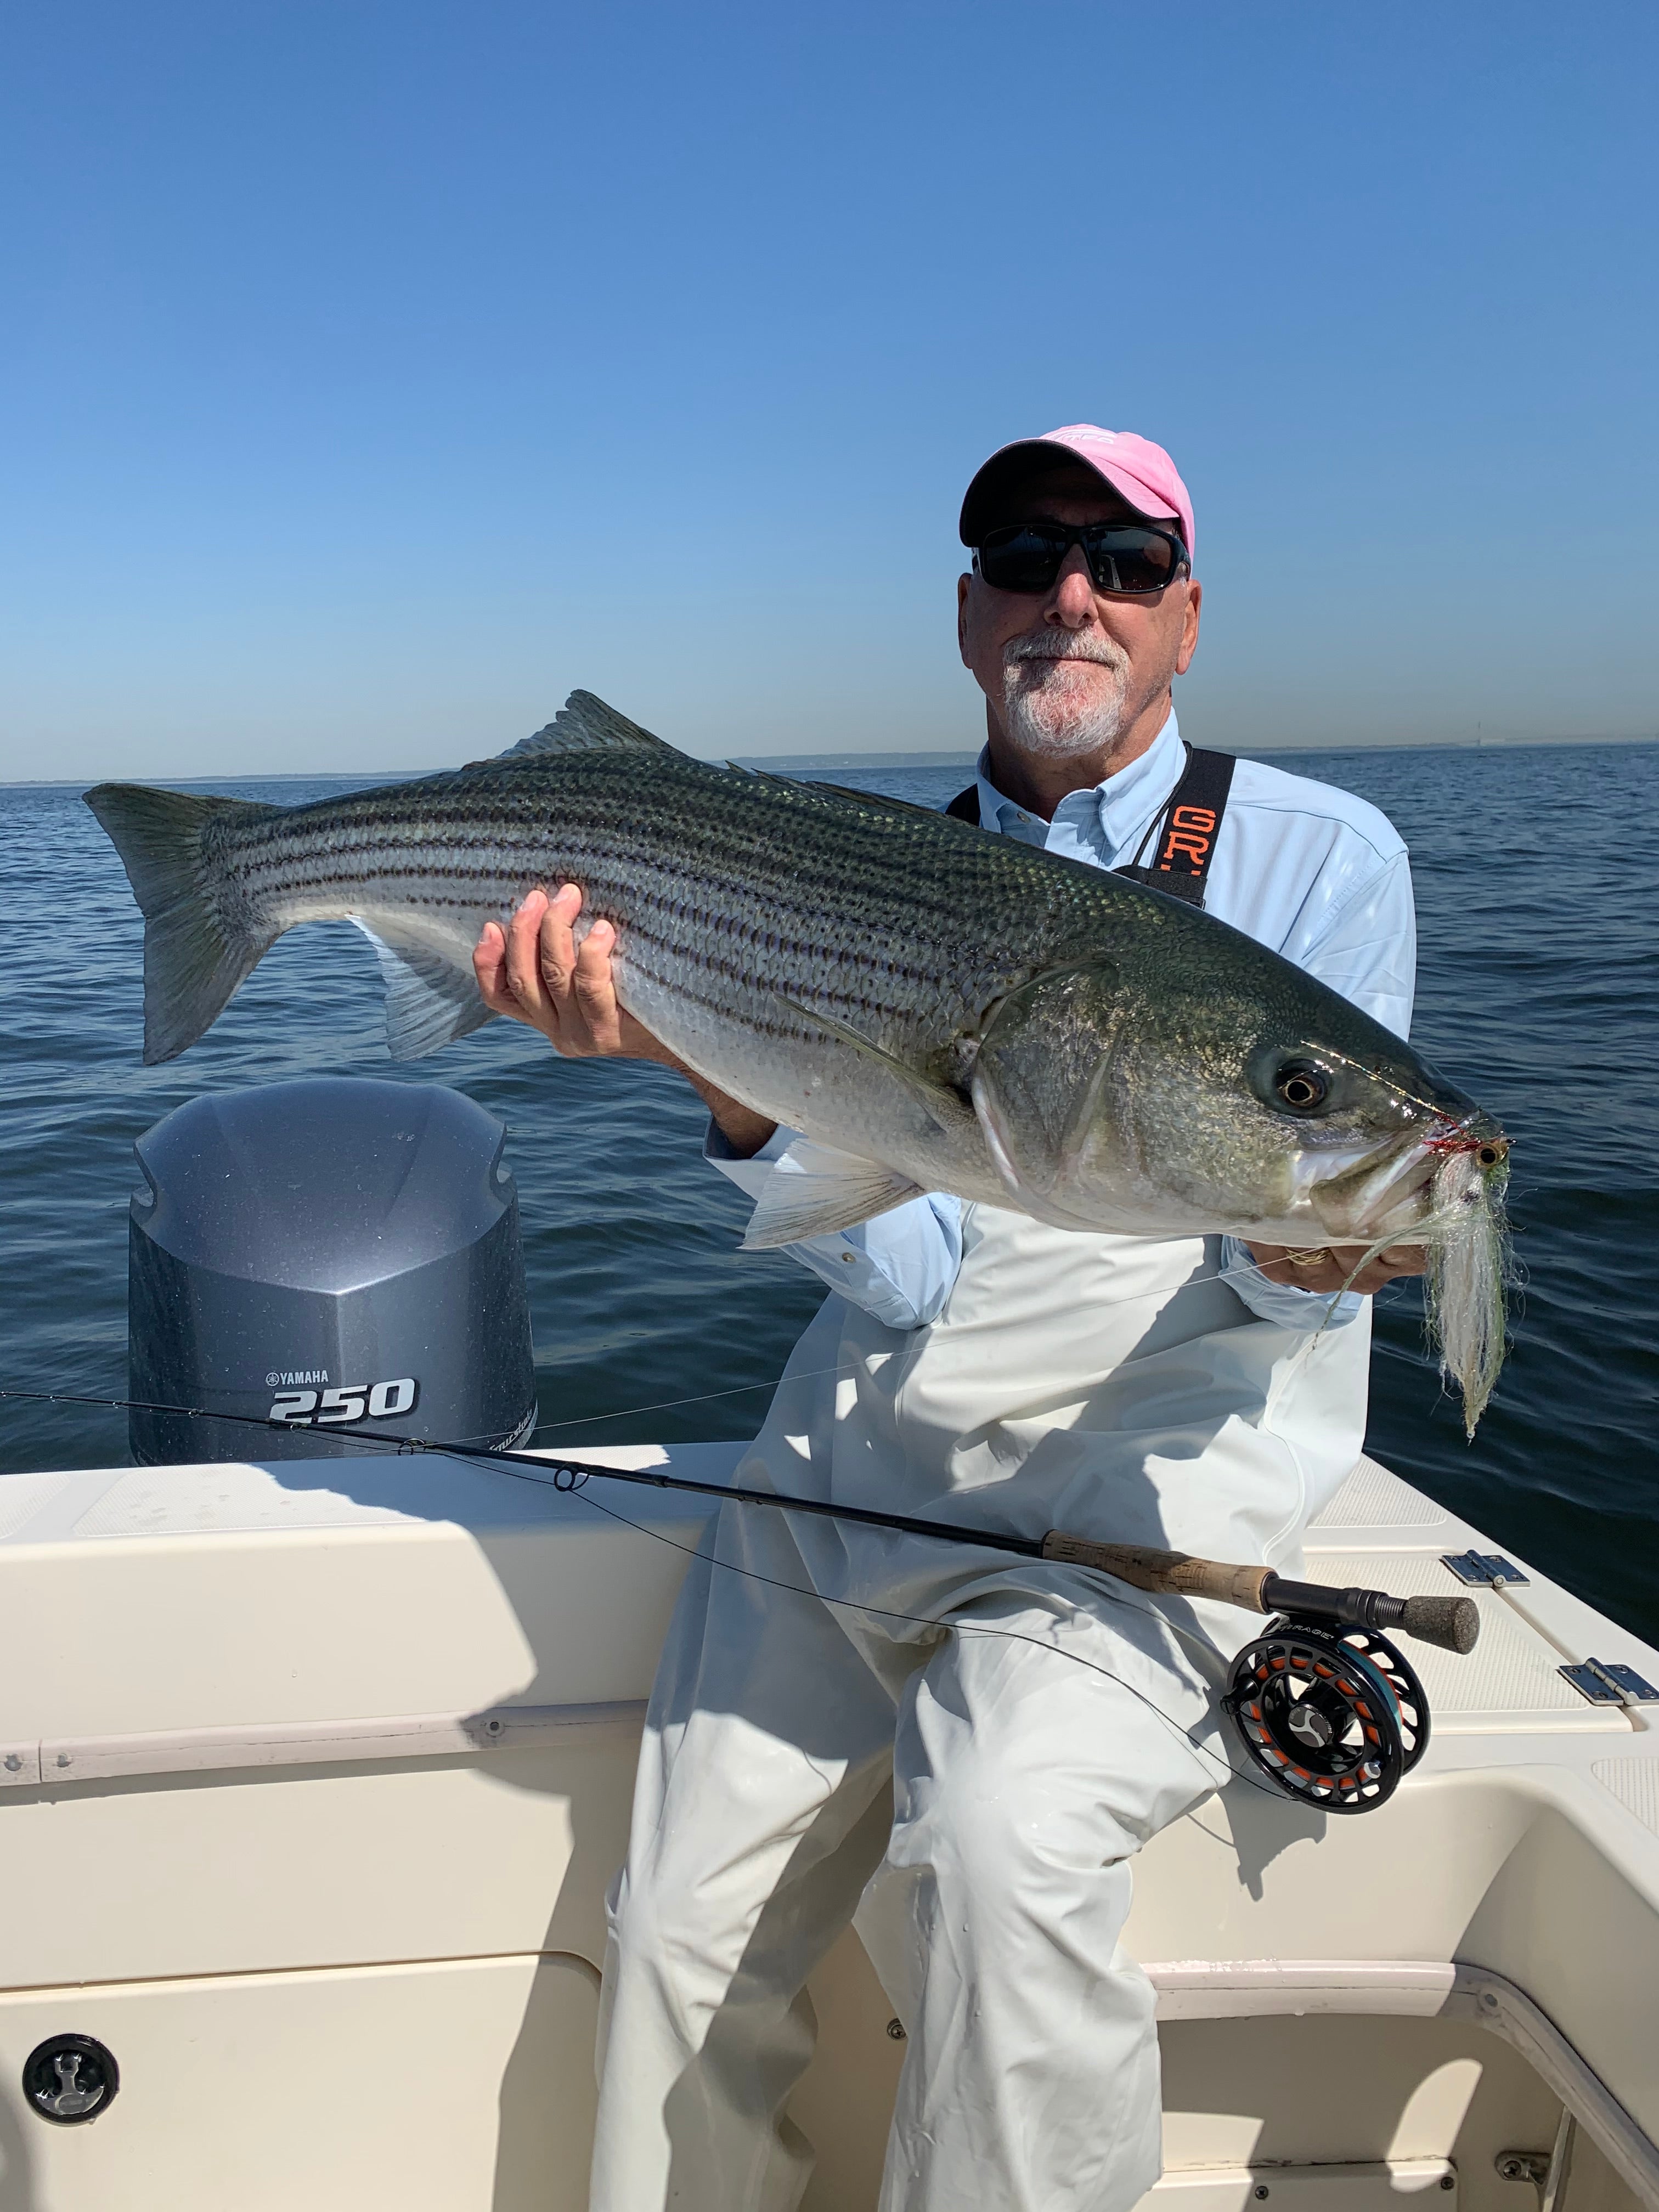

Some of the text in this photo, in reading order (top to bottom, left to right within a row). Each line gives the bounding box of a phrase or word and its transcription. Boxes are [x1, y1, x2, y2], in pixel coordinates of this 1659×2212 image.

[1159, 805, 1216, 876] GR
[280, 1370, 329, 1385] YAMAHA
[269, 1378, 415, 1424] 250
